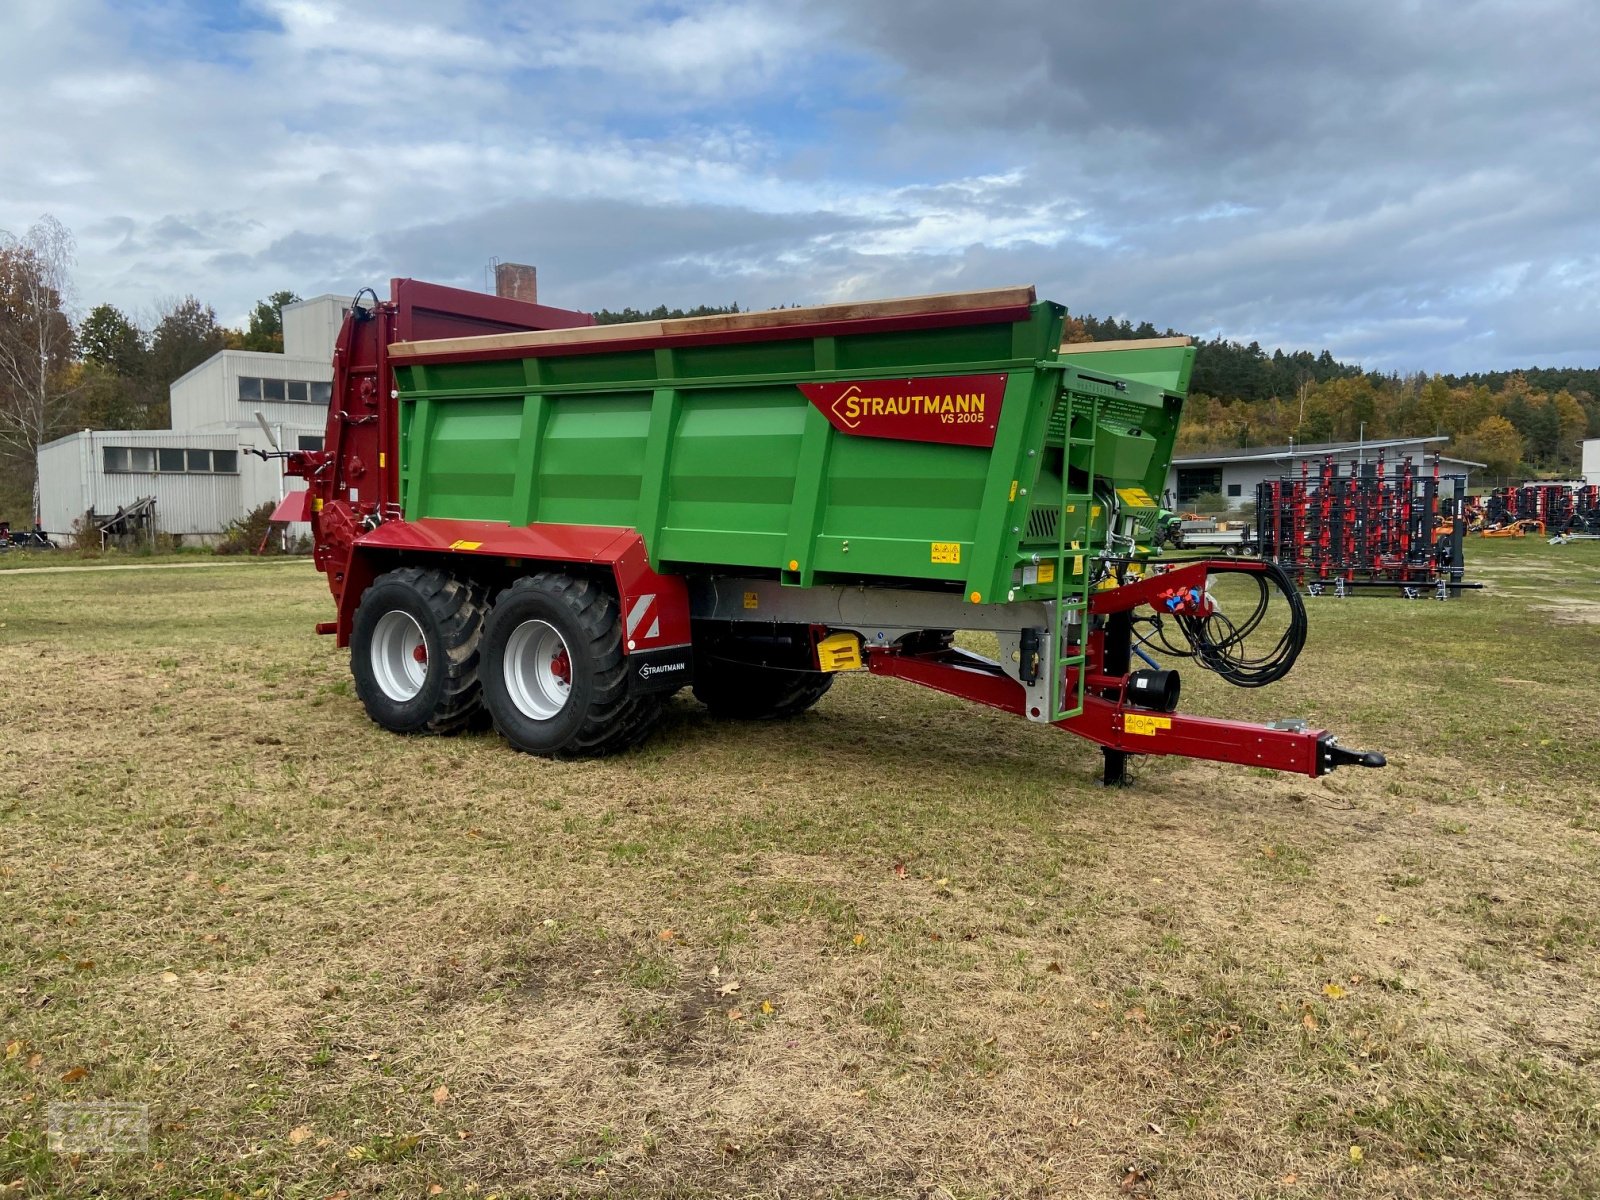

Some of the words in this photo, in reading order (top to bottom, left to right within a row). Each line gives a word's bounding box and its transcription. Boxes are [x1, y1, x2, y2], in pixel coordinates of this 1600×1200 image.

[845, 393, 985, 418] STRAUTMANN
[940, 413, 955, 424] VS
[956, 412, 985, 424] 2005
[643, 662, 685, 676] STRAUTMANN
